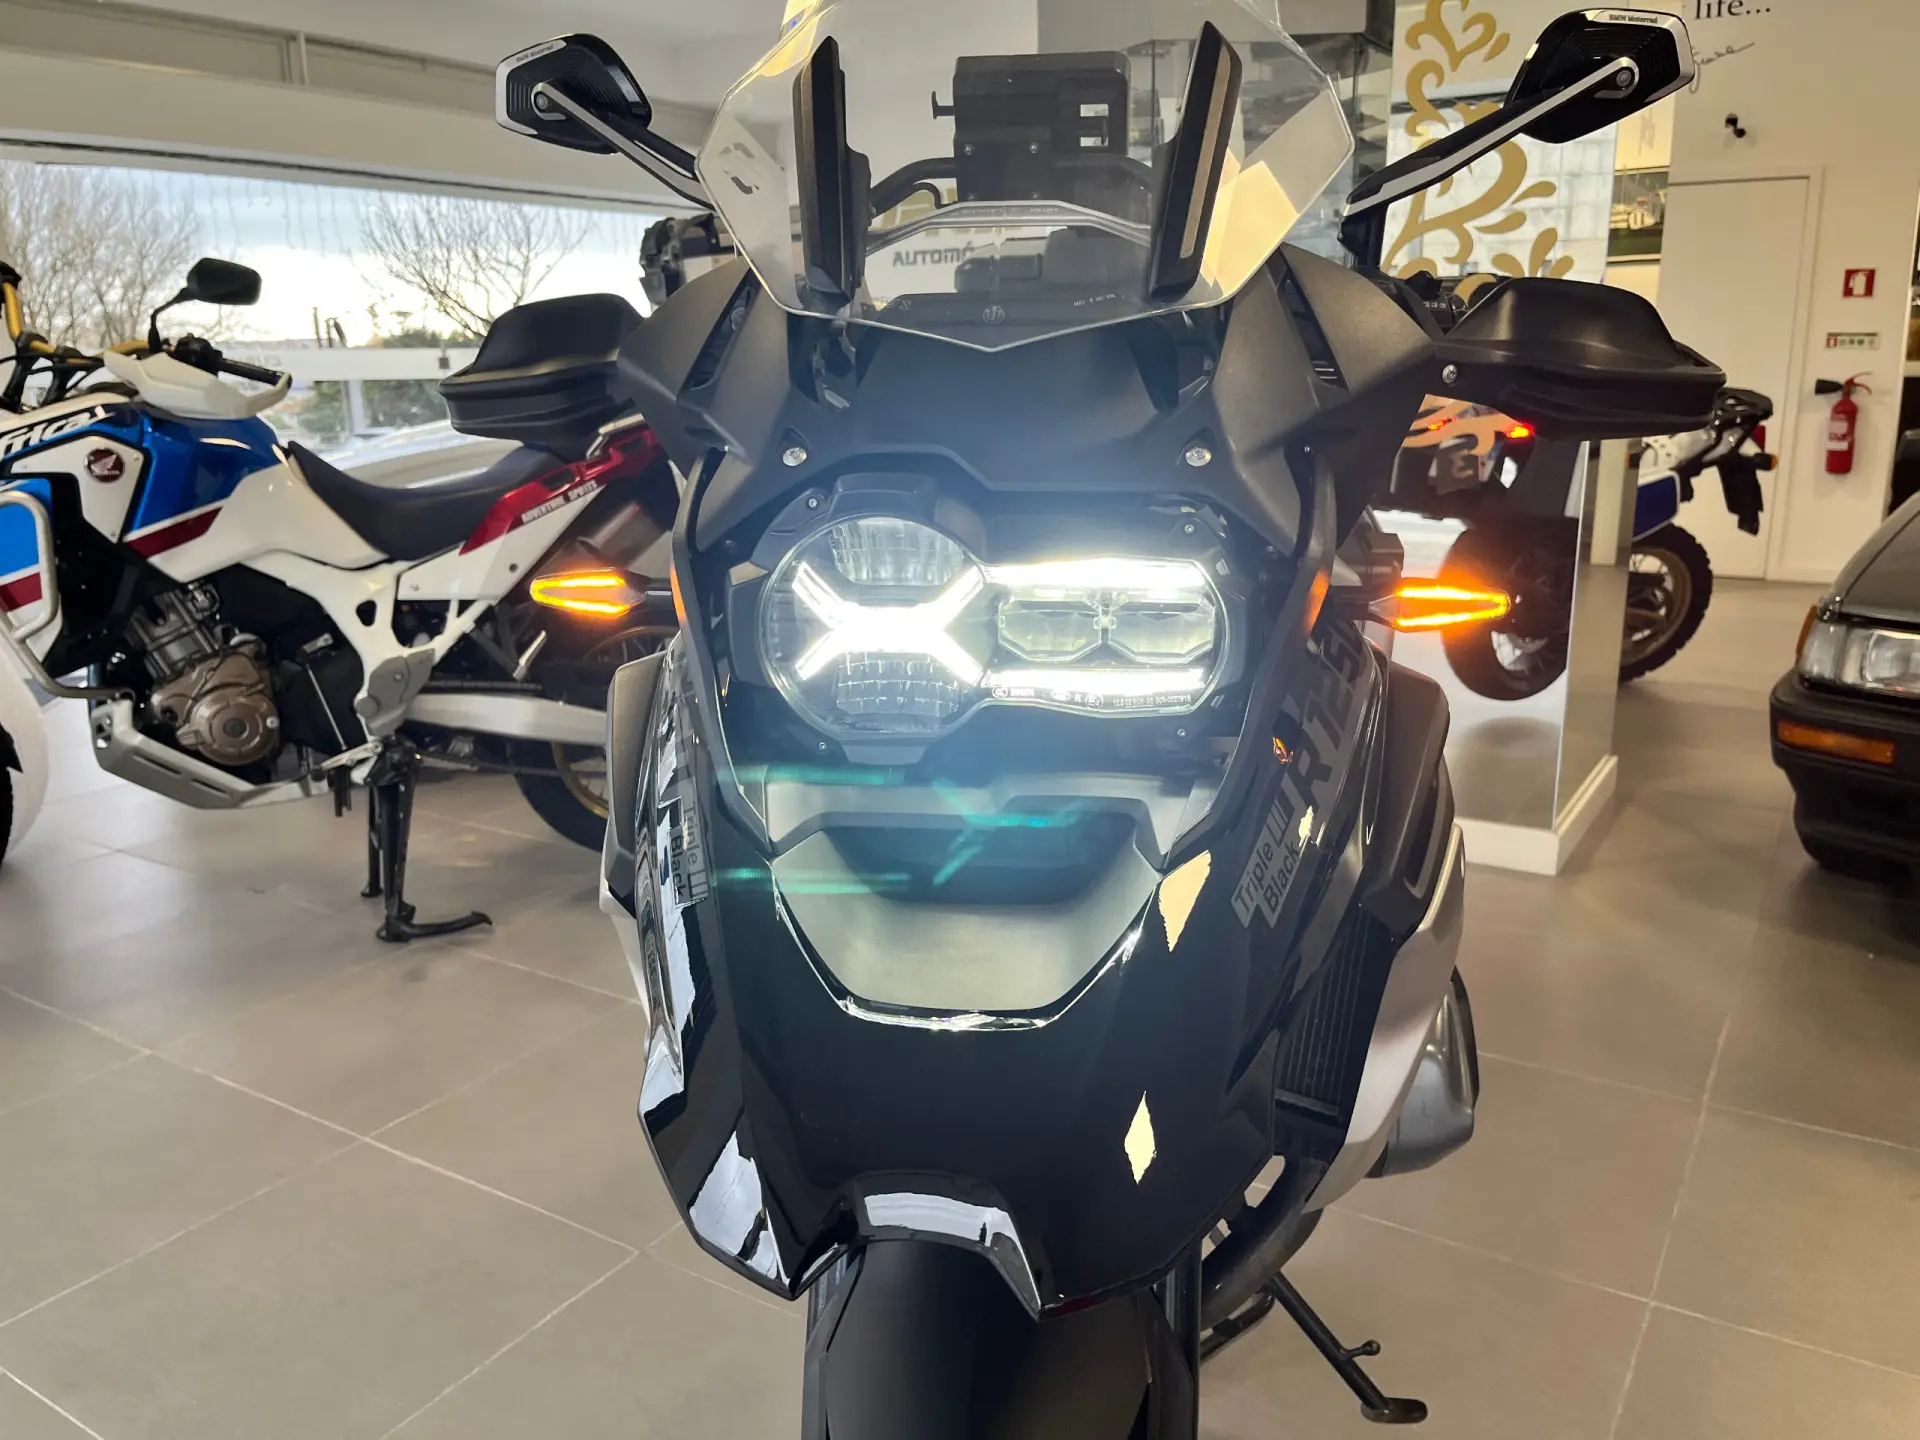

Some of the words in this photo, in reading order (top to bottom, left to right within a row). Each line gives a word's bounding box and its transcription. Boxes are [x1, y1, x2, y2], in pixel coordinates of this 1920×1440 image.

[671, 835, 686, 898] Black
[1236, 842, 1274, 914] Triple
[1263, 841, 1301, 914] Black
